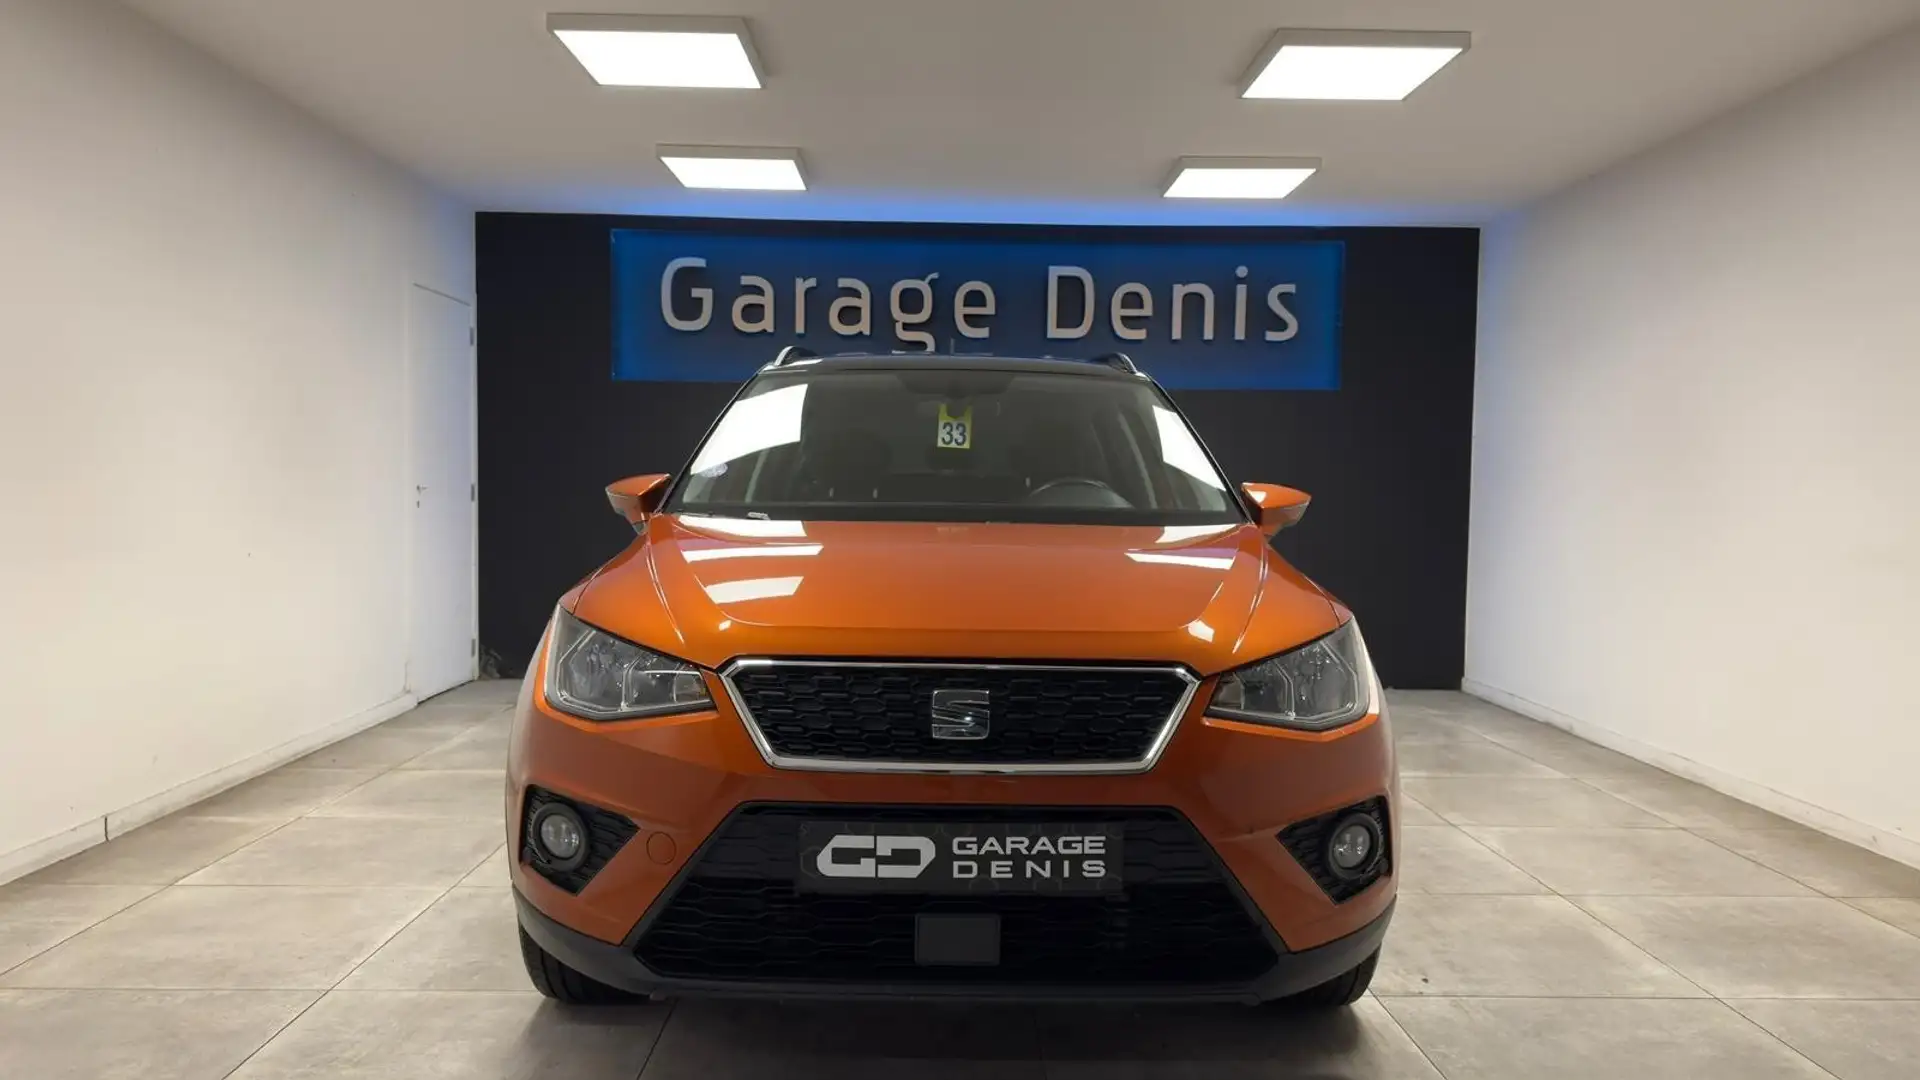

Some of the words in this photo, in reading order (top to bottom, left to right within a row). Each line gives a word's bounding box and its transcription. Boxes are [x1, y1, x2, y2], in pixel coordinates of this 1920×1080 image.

[660, 257, 997, 353] Garage
[1046, 265, 1300, 342] Denis
[941, 422, 967, 446] 33
[951, 835, 1107, 856] GARAGE
[951, 859, 1107, 879] DENIS
